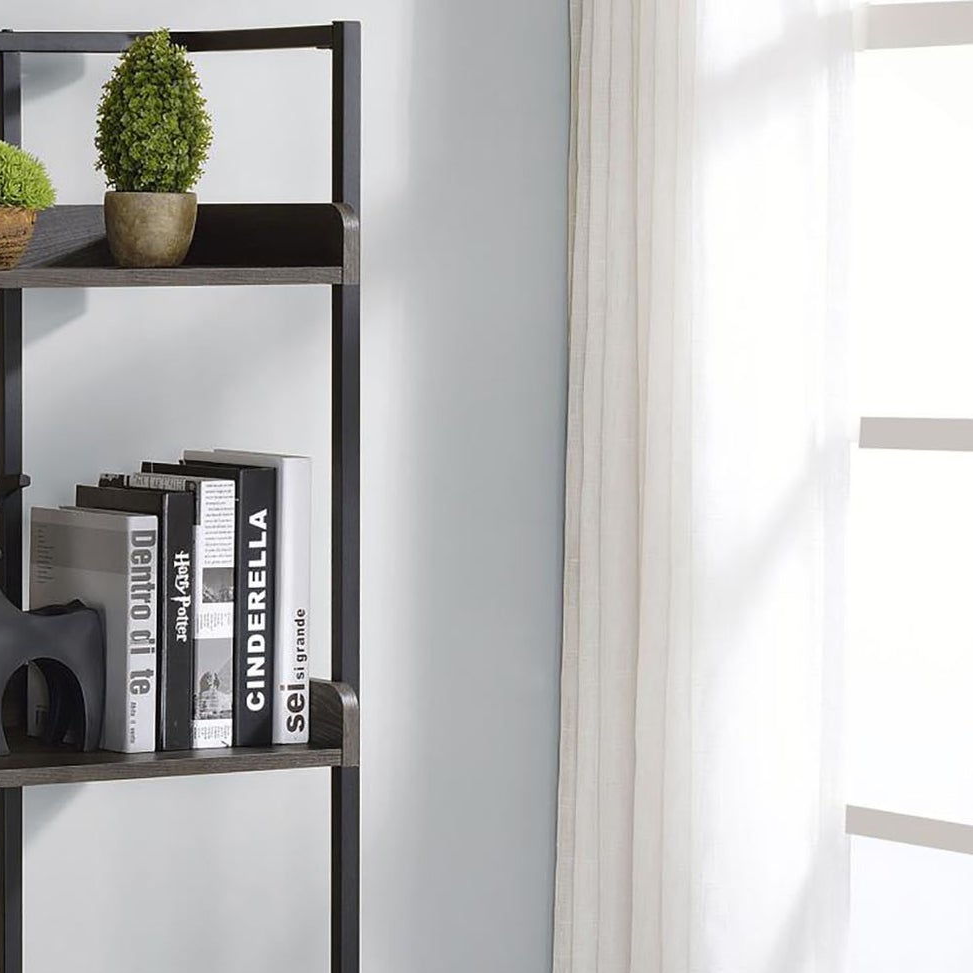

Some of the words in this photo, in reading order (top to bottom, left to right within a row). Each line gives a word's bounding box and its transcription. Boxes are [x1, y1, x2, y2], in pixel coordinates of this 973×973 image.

[130, 529, 156, 620] Dentro
[174, 550, 190, 594] Harry
[170, 595, 191, 642] Potter
[246, 508, 268, 712] CINDERELLA
[130, 630, 155, 654] di
[294, 608, 307, 662] grande
[130, 669, 154, 695] te
[294, 667, 305, 680] si
[280, 682, 305, 733] sei
